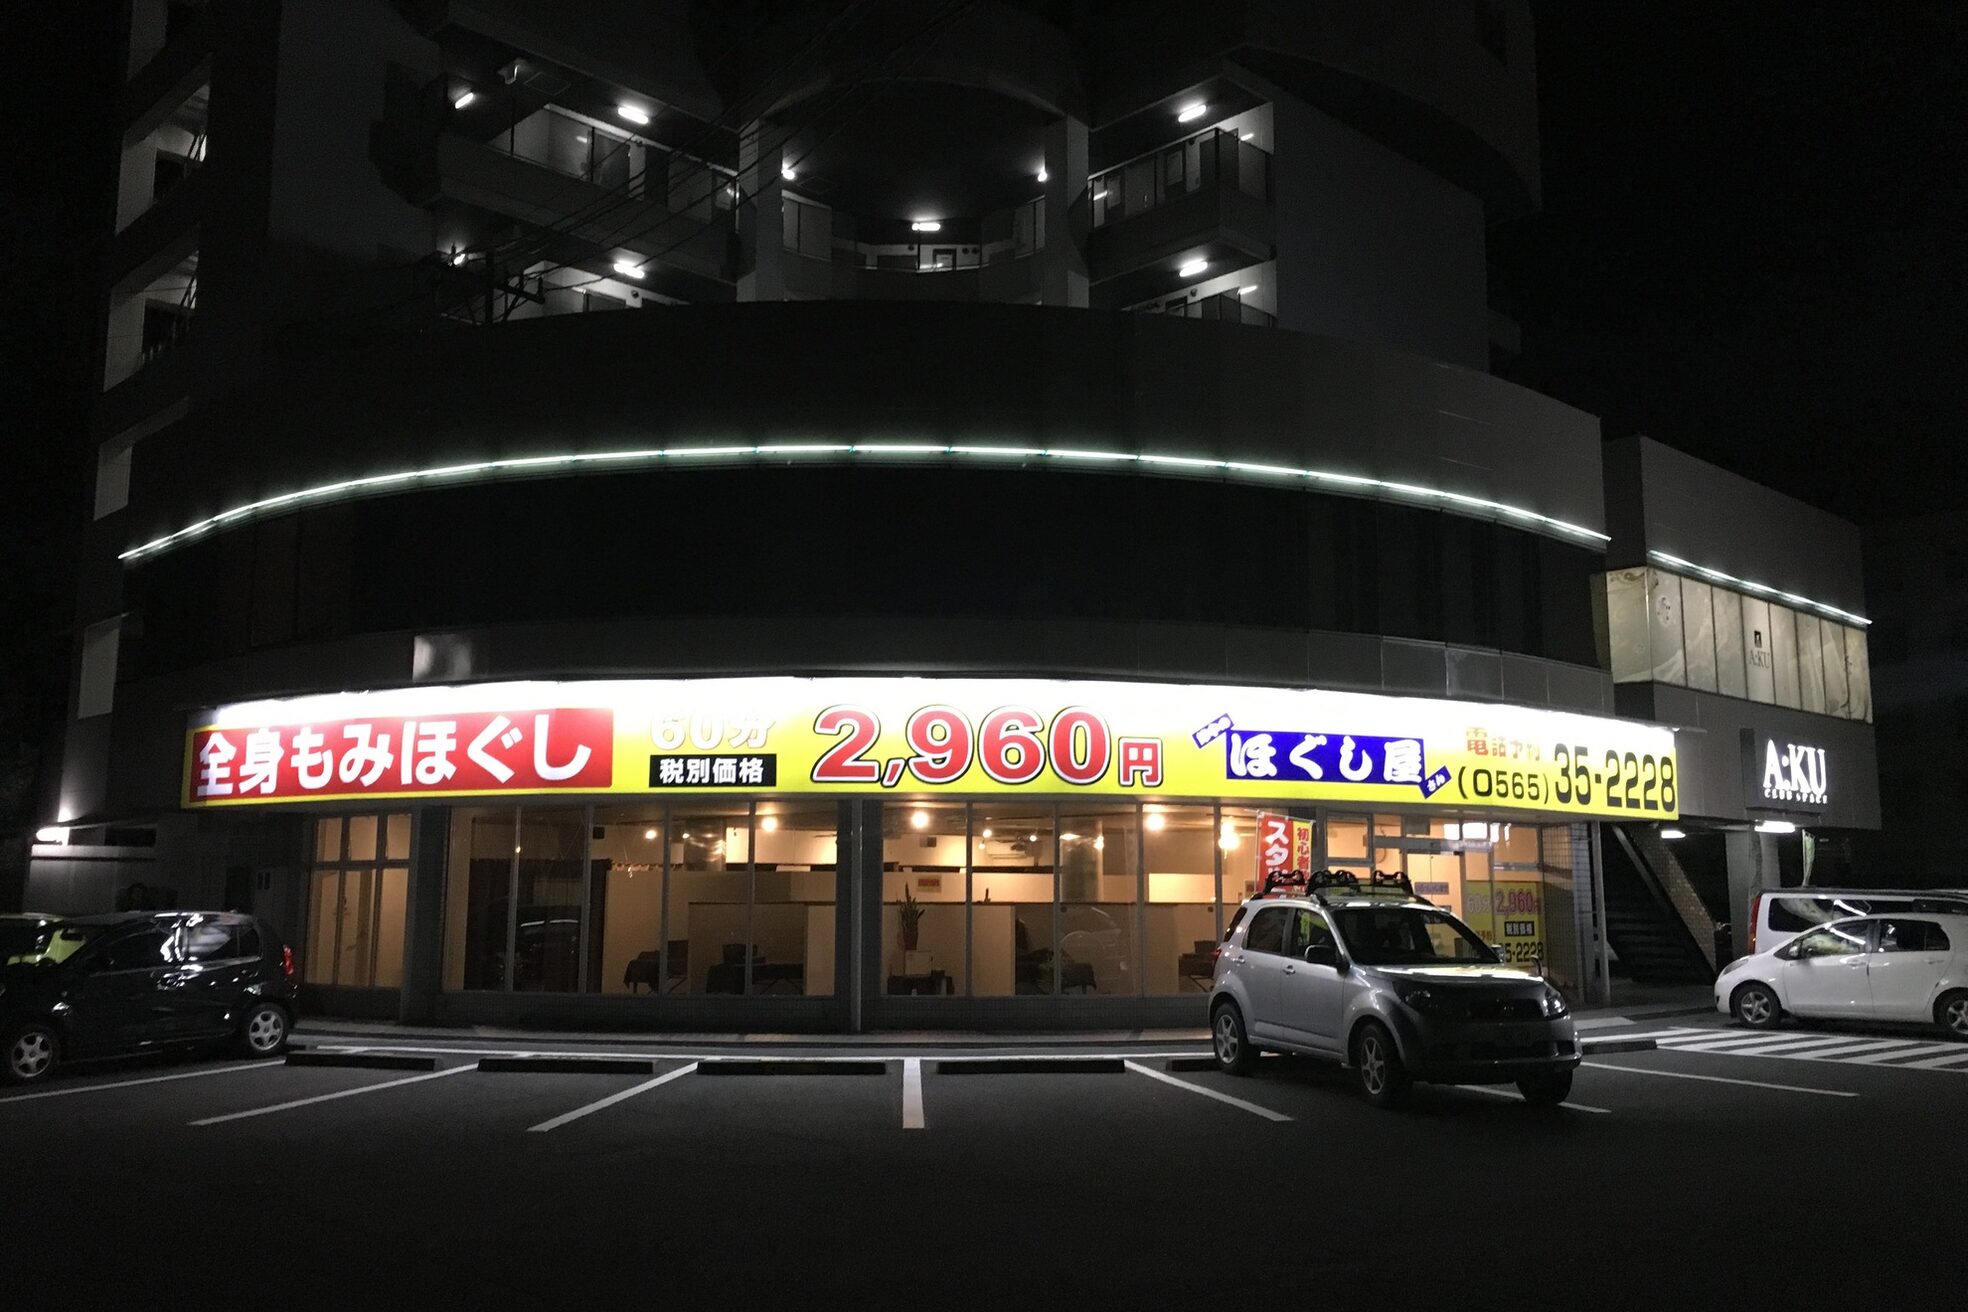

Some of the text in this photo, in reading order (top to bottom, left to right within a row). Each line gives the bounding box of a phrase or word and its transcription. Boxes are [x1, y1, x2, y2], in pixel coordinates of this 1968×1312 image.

[650, 708, 776, 751] 60分
[811, 704, 1164, 788] 2,960円
[197, 711, 591, 796] 全身もみほぐし
[659, 757, 764, 784] 税別価格
[1229, 732, 1425, 784] ほぐし屋
[1458, 766, 1549, 805] (0565)
